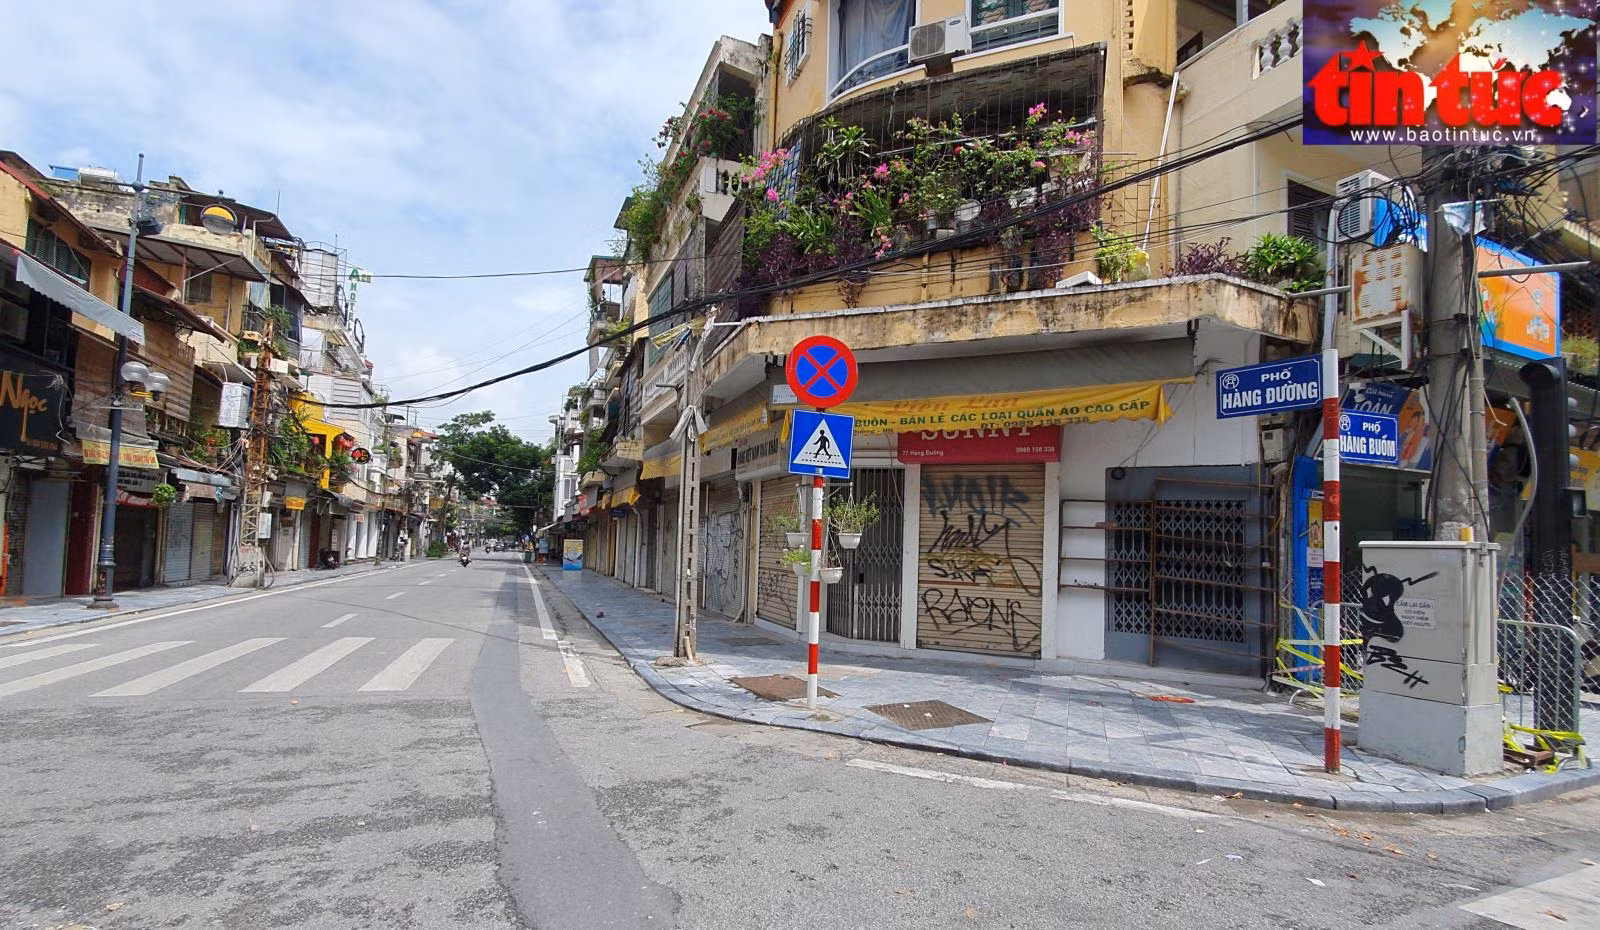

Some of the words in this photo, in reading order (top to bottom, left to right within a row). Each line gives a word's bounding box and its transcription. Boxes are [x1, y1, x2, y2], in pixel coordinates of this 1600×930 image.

[348, 282, 357, 331] HOTEL
[1261, 366, 1293, 382] PHỐ
[1222, 388, 1262, 410] HÀNG
[1265, 380, 1318, 405] ĐƯỜNG
[854, 417, 888, 428] BUÔN
[900, 413, 926, 425] BÁN
[950, 411, 977, 423] CÁC
[1085, 402, 1114, 414] CAO
[1119, 398, 1150, 411] CẤP
[1362, 421, 1381, 433] PHỐ
[1340, 431, 1367, 454] HÀNG
